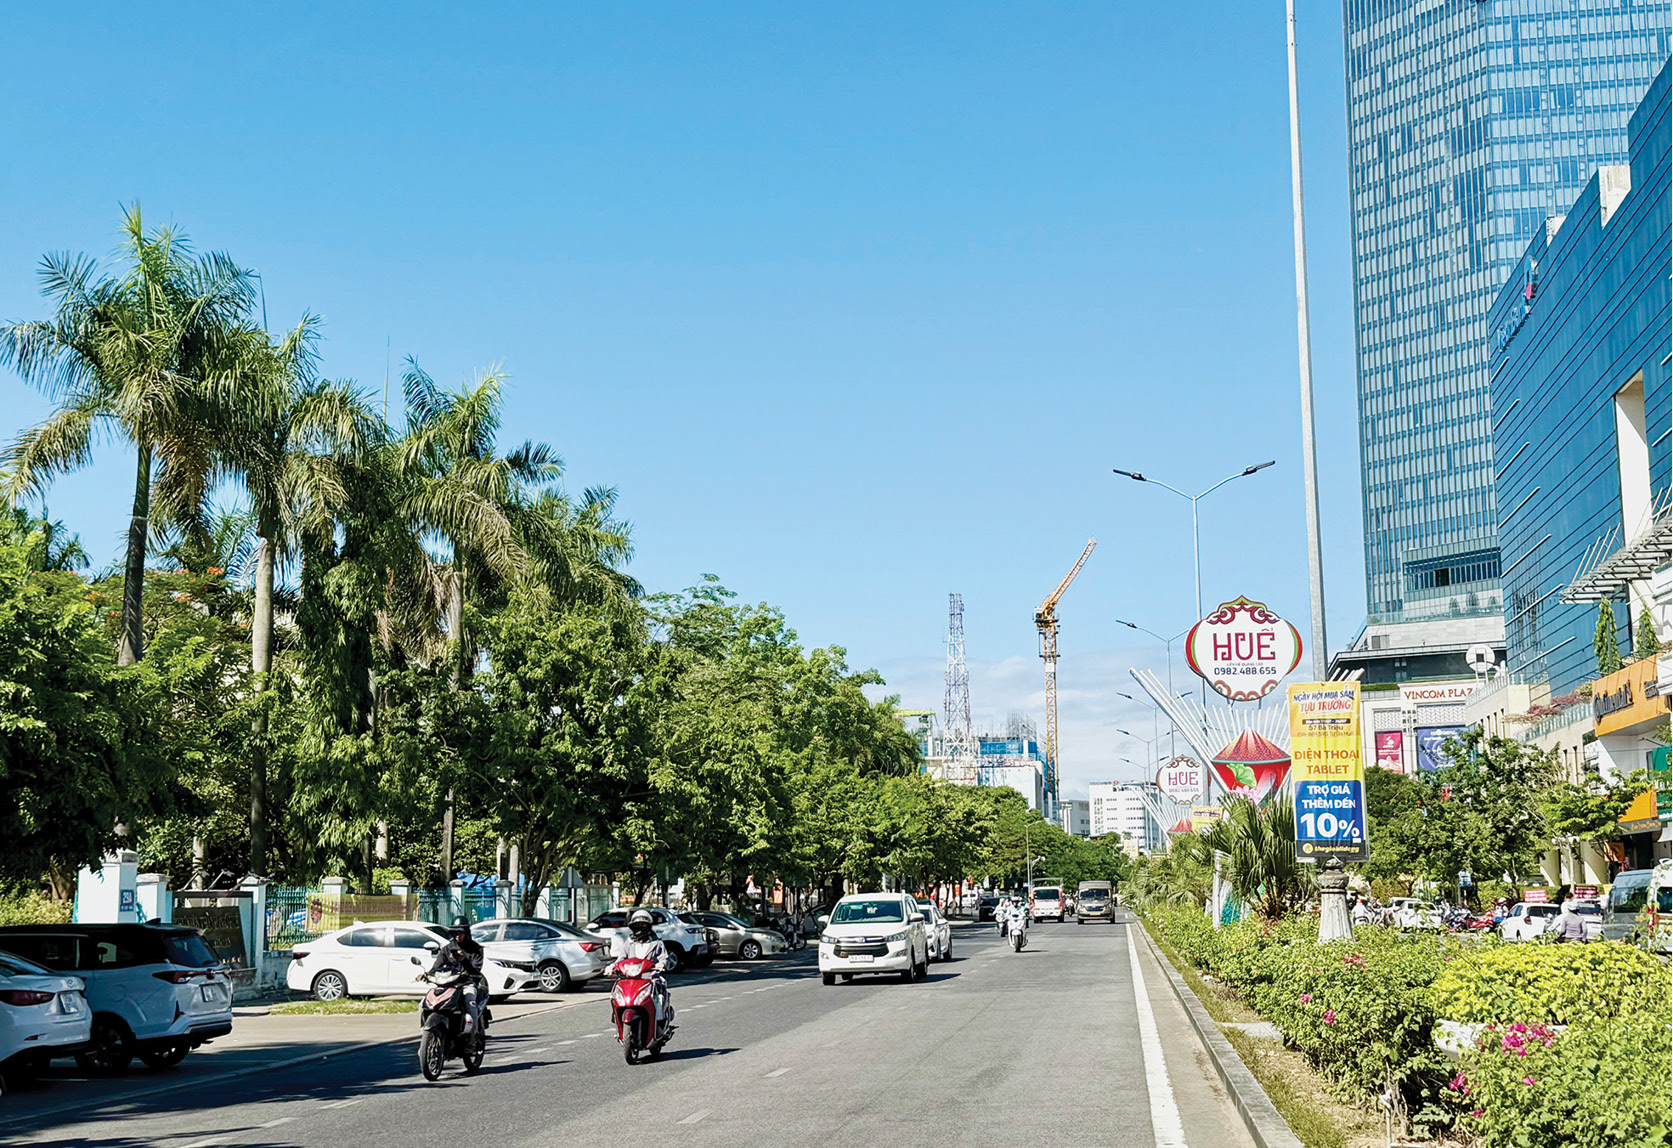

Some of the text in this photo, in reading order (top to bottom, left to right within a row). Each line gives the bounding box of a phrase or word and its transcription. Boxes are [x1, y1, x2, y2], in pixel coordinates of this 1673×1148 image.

[1213, 627, 1276, 661] HUẾ
[1213, 666, 1277, 676] 0982.488.655
[1404, 687, 1473, 700] VINCOM PLAZ
[1294, 748, 1360, 762] ĐIỆN THOẠI
[1306, 765, 1349, 774] TABLET
[1306, 783, 1351, 797] TRỢ GIÁ
[1302, 796, 1356, 809] THÊM ĐẾN
[1300, 812, 1360, 838] 10%
